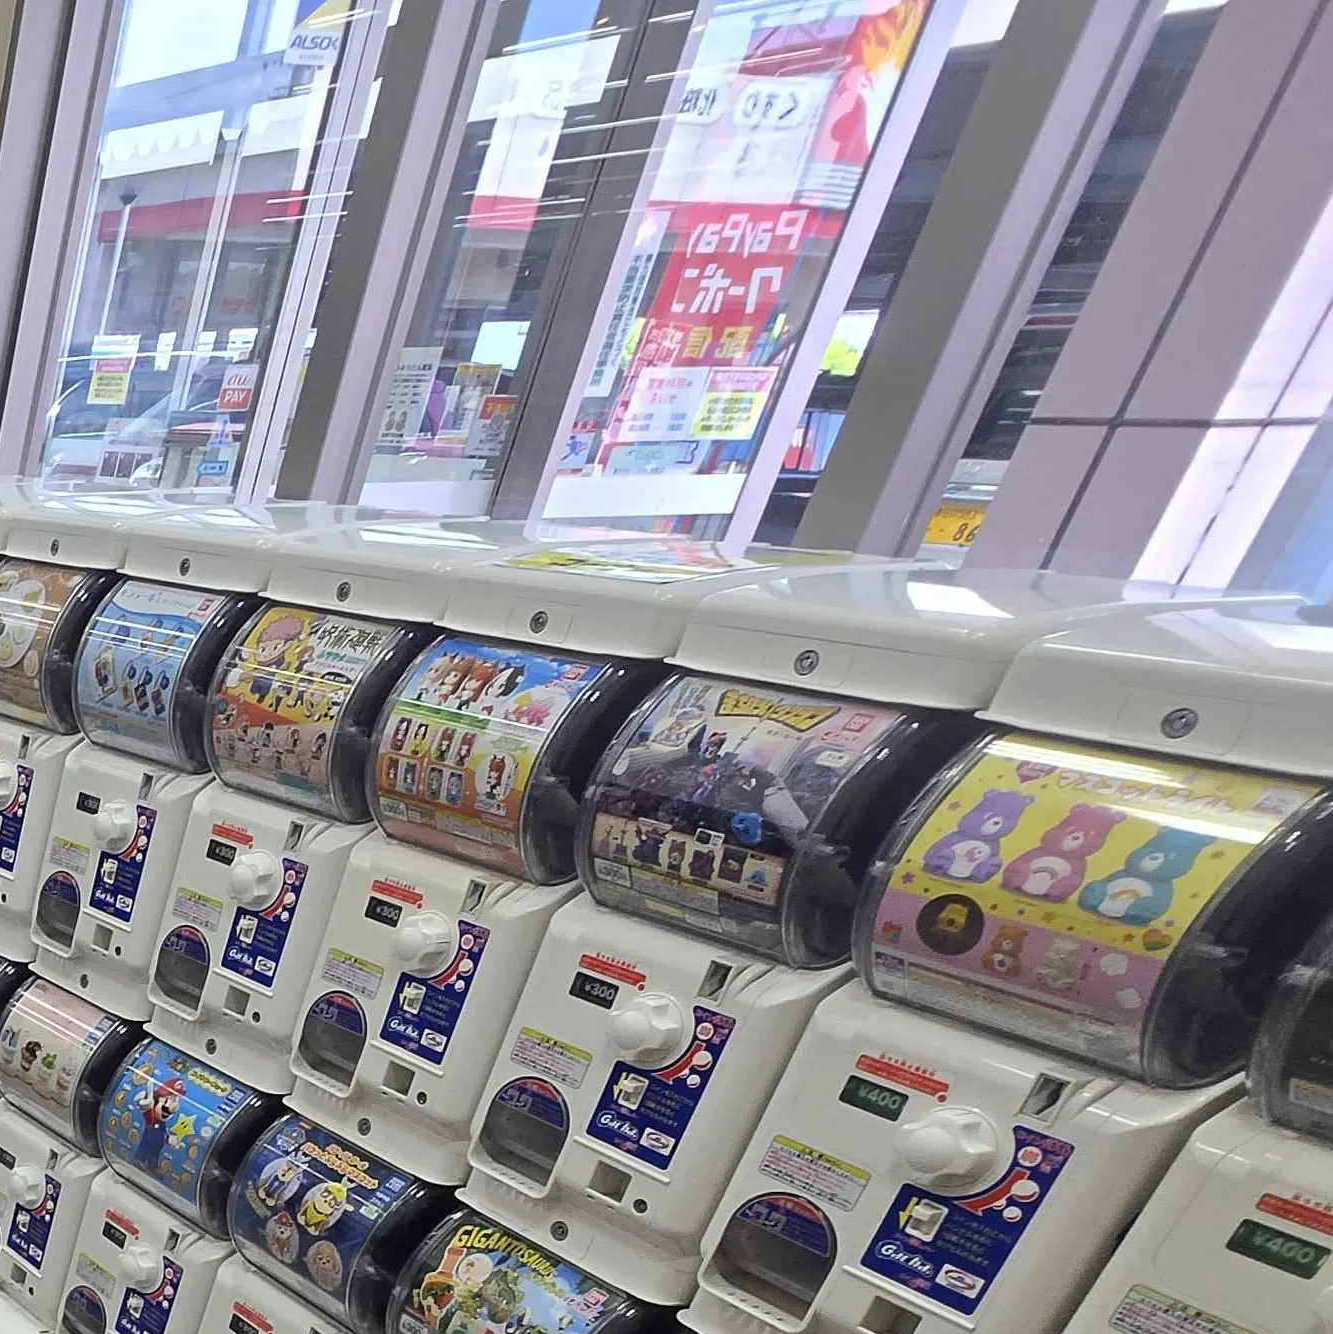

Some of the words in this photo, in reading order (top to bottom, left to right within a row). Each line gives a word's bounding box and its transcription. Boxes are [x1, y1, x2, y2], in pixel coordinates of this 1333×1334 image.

[223, 392, 247, 404] PAY
[584, 980, 614, 1001] ¥300
[859, 1083, 900, 1110] ¥400
[1252, 1230, 1314, 1265] ¥400
